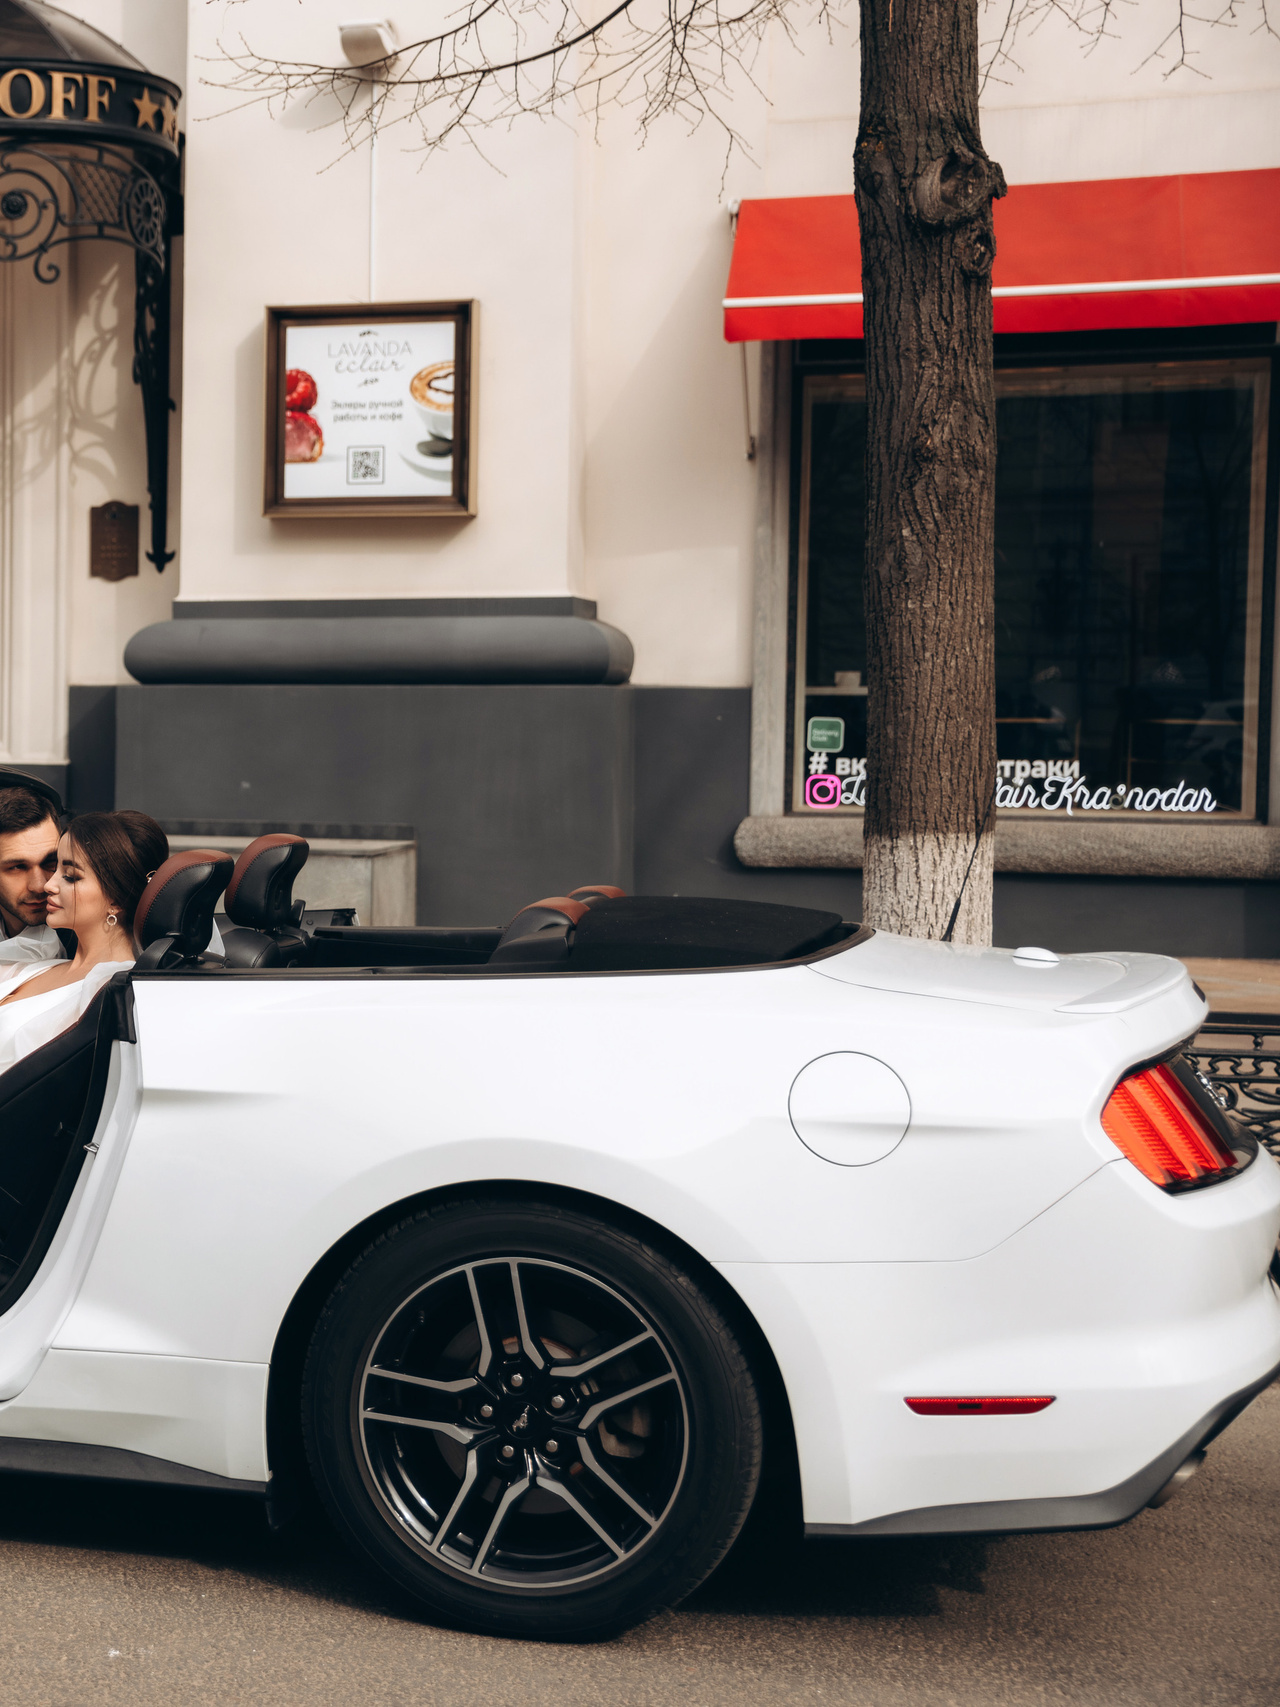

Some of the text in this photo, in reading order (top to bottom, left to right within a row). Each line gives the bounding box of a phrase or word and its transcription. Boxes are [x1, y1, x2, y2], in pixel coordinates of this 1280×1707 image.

[327, 341, 412, 359] LAVANDA
[331, 399, 403, 410] Эклеры ручной
[333, 412, 367, 423] работы
[379, 412, 403, 422] кофе
[996, 759, 1080, 785] траки
